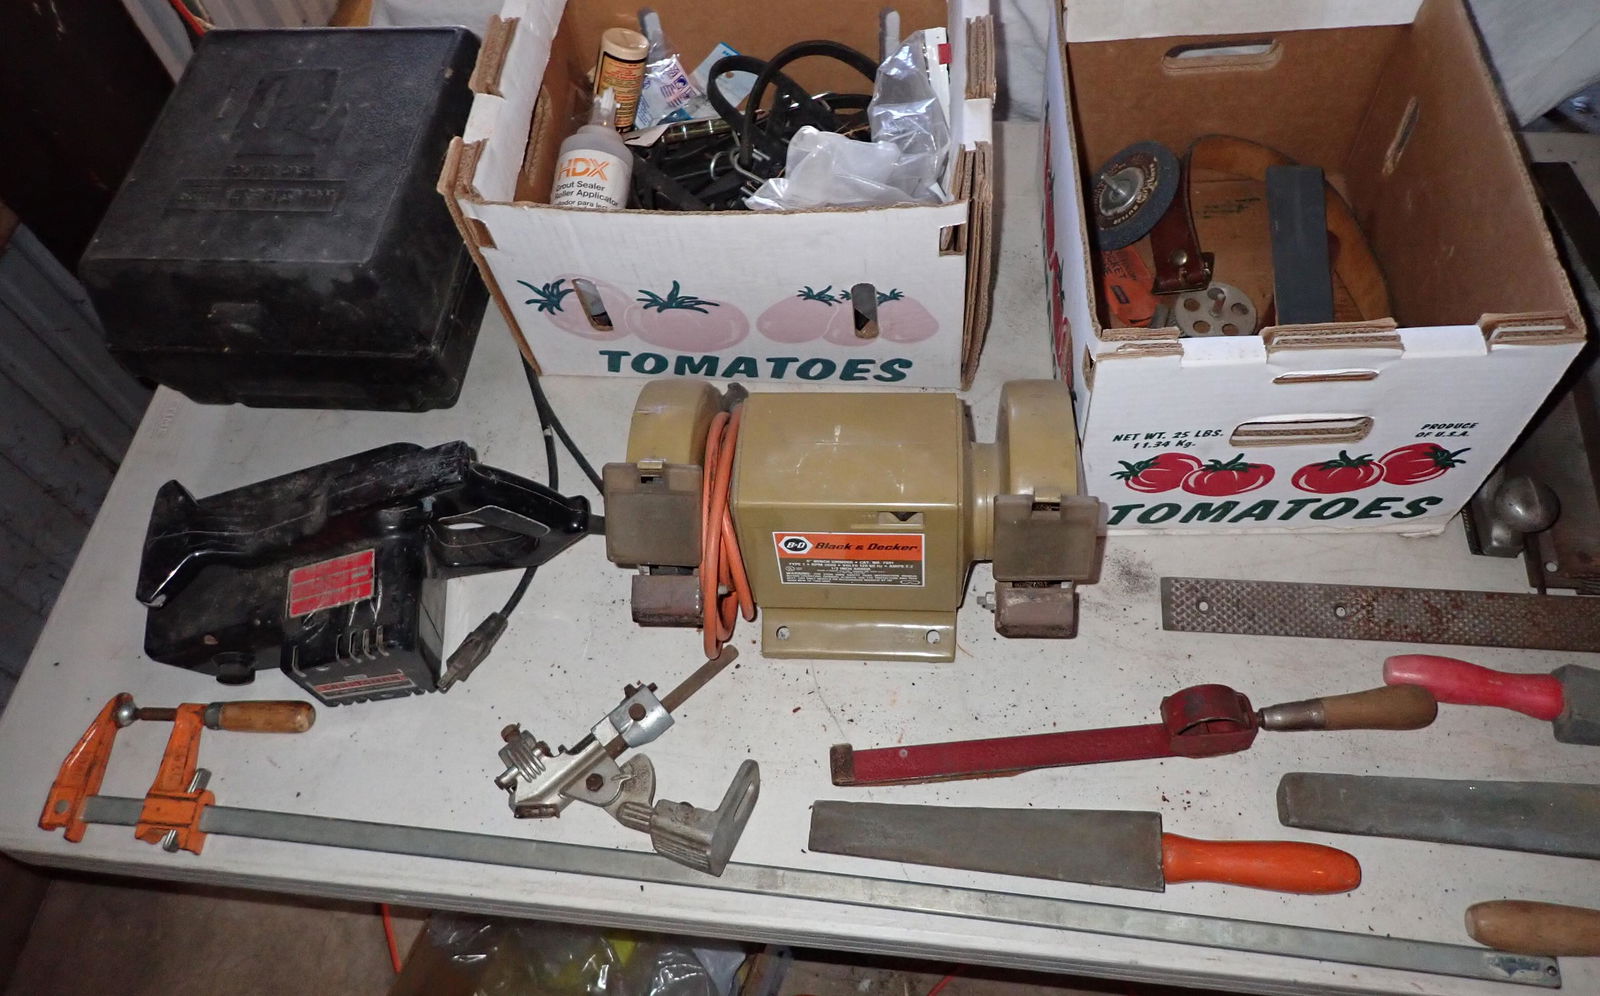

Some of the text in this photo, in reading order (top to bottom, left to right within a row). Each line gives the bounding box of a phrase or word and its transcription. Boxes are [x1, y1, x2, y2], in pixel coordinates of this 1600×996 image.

[558, 158, 609, 181] HDX
[577, 181, 606, 191] Sealer
[576, 189, 619, 206] Applicator
[598, 350, 913, 382] TOMATOES
[1421, 422, 1479, 430] PRODUCE
[1112, 429, 1225, 442] NET WT. 25 LBS.
[1133, 440, 1171, 449] 11.34
[1107, 496, 1444, 525] TOMATOES
[815, 542, 852, 551] Black
[867, 542, 919, 551] Decker
